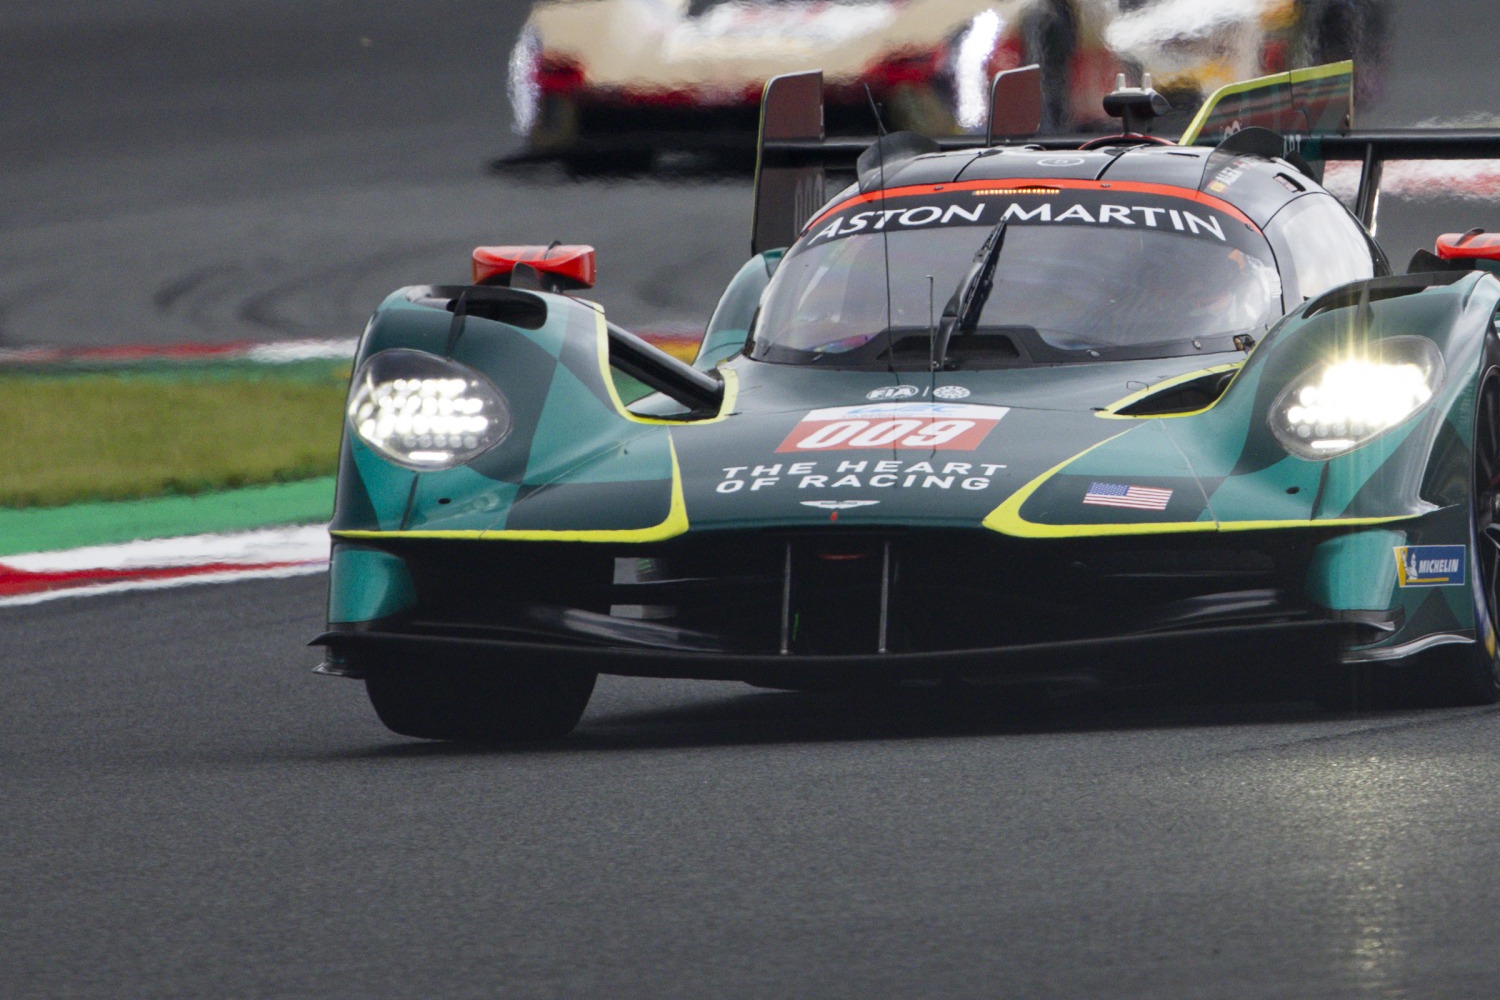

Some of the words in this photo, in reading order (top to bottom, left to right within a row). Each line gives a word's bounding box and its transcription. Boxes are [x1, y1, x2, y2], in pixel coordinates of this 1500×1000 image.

[807, 203, 986, 246] ASTON
[1000, 203, 1227, 241] MARTIN
[796, 418, 976, 449] 009
[722, 462, 817, 479] THE
[836, 460, 1007, 476] HEART
[716, 477, 780, 493] OF
[797, 474, 991, 491] RACING
[1418, 558, 1459, 574] MICHELIN
